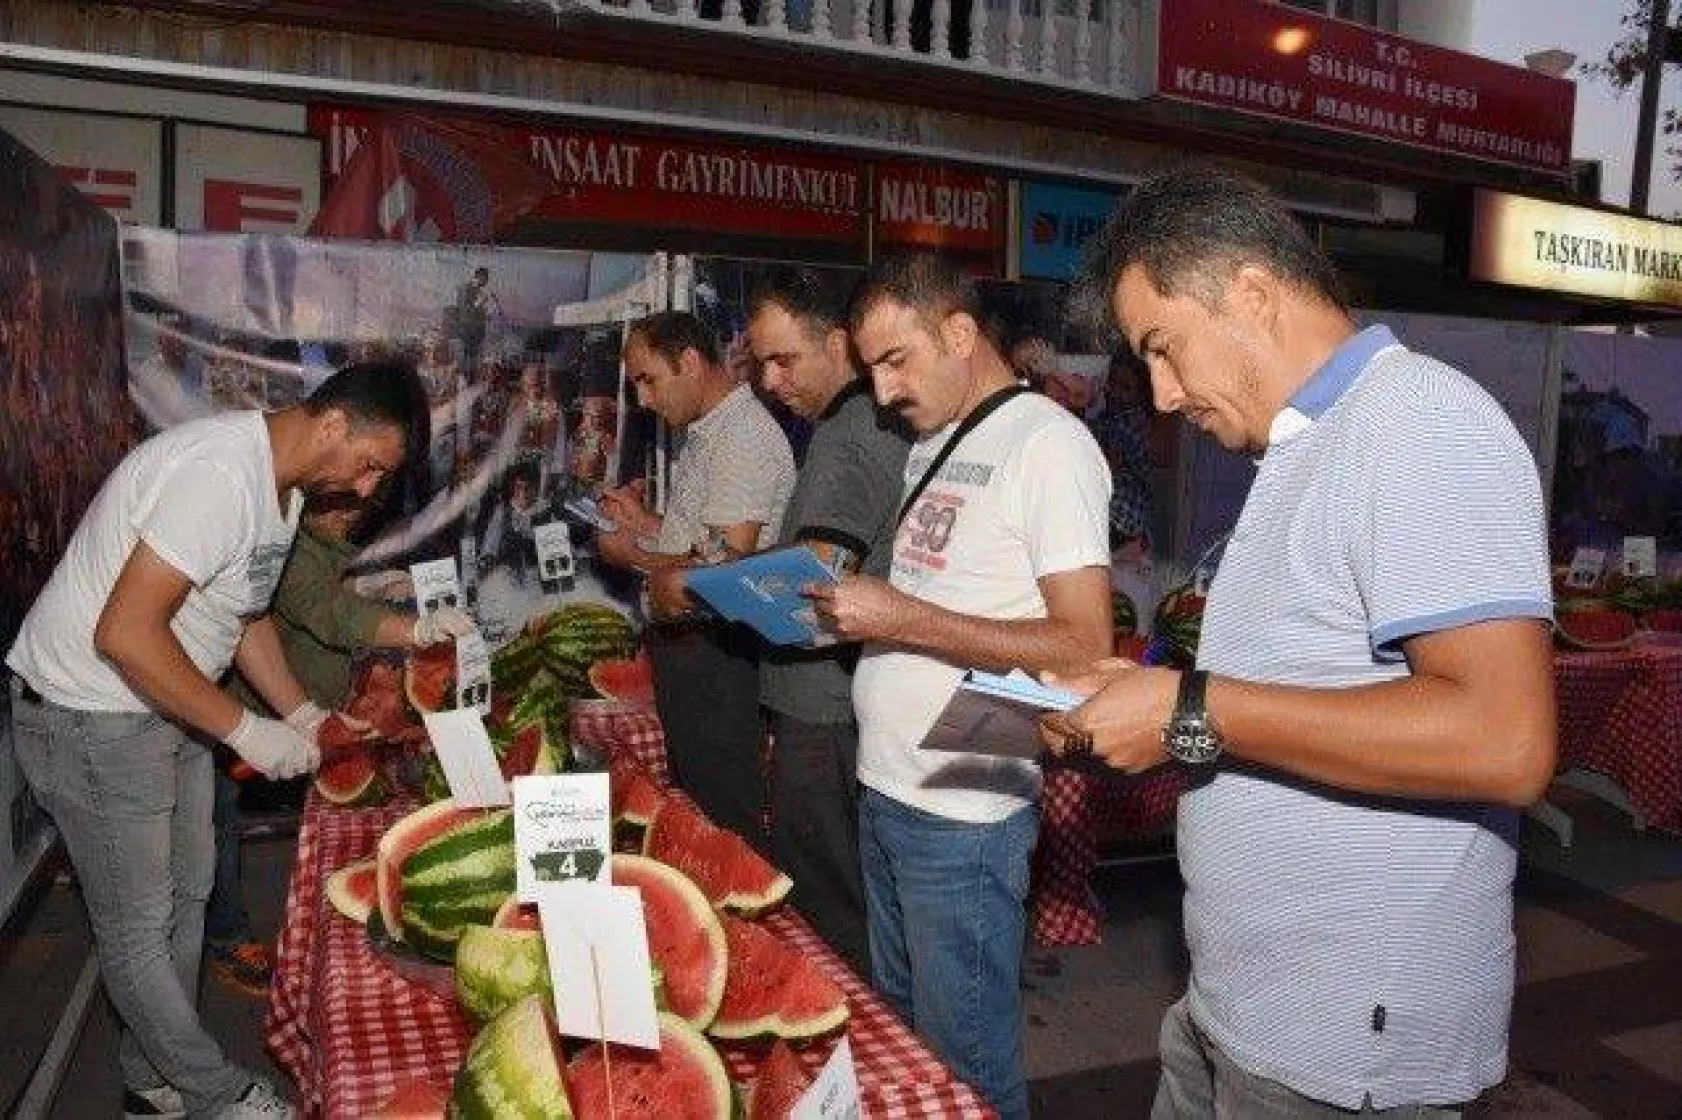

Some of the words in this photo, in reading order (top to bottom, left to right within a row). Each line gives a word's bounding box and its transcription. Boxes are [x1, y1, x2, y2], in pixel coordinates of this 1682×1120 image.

[1375, 41, 1418, 69] T.C.
[1314, 95, 1427, 136] MAHALLE
[879, 177, 990, 231] NALBUR
[1534, 230, 1629, 273] TAŞKIRAN
[558, 853, 579, 877] 4
